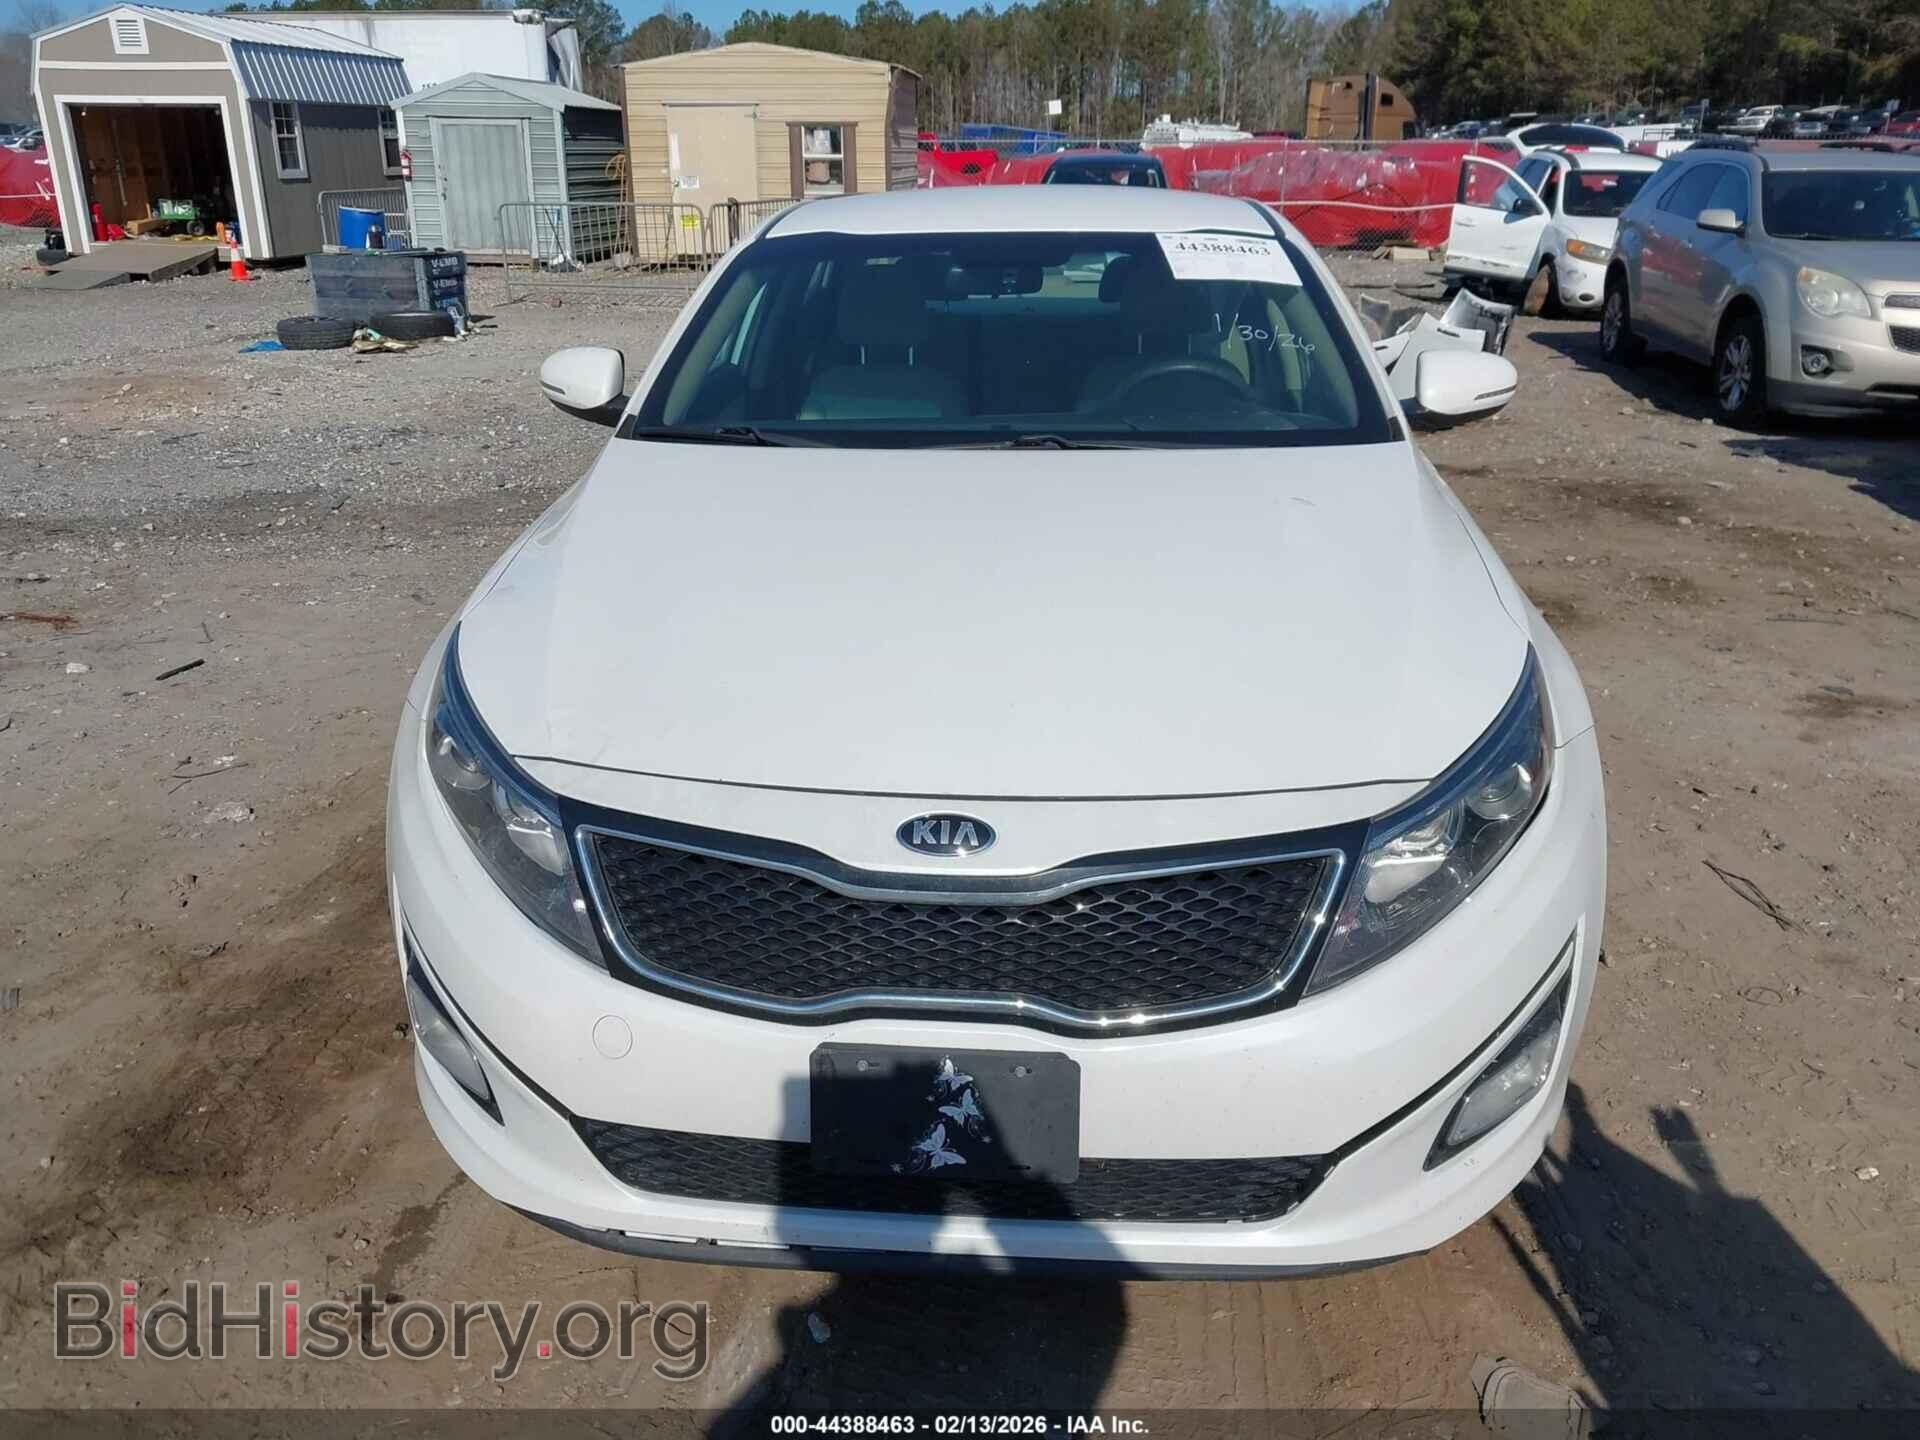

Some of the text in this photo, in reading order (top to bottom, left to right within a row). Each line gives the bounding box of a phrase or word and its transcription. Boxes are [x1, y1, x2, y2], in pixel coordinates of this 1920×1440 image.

[1175, 241, 1271, 256] 44388463
[1214, 312, 1315, 351] 1/30/26
[913, 820, 979, 846] KIA
